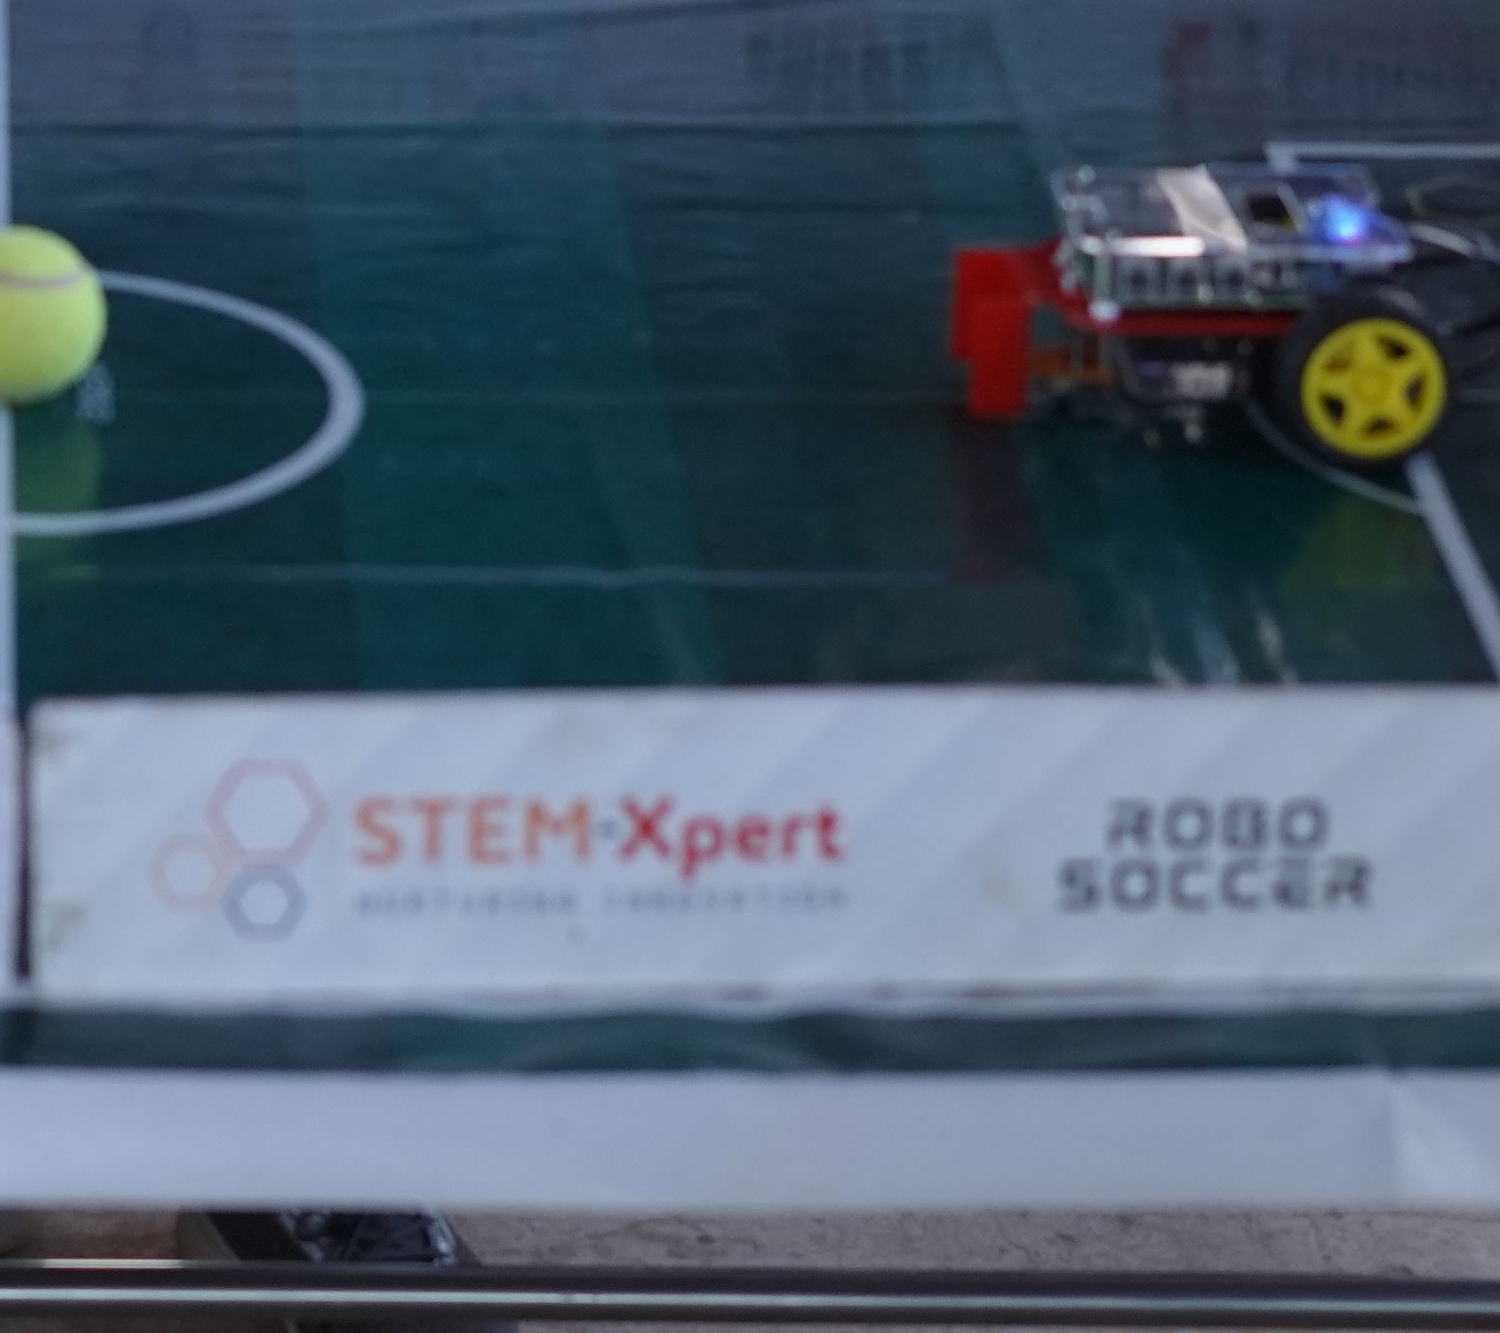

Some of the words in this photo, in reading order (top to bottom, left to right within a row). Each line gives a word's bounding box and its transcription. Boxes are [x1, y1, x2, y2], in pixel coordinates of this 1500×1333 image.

[355, 795, 847, 883] STEM-Xpert
[1105, 797, 1330, 853] ROBO
[1058, 854, 1373, 914] SOCCER
